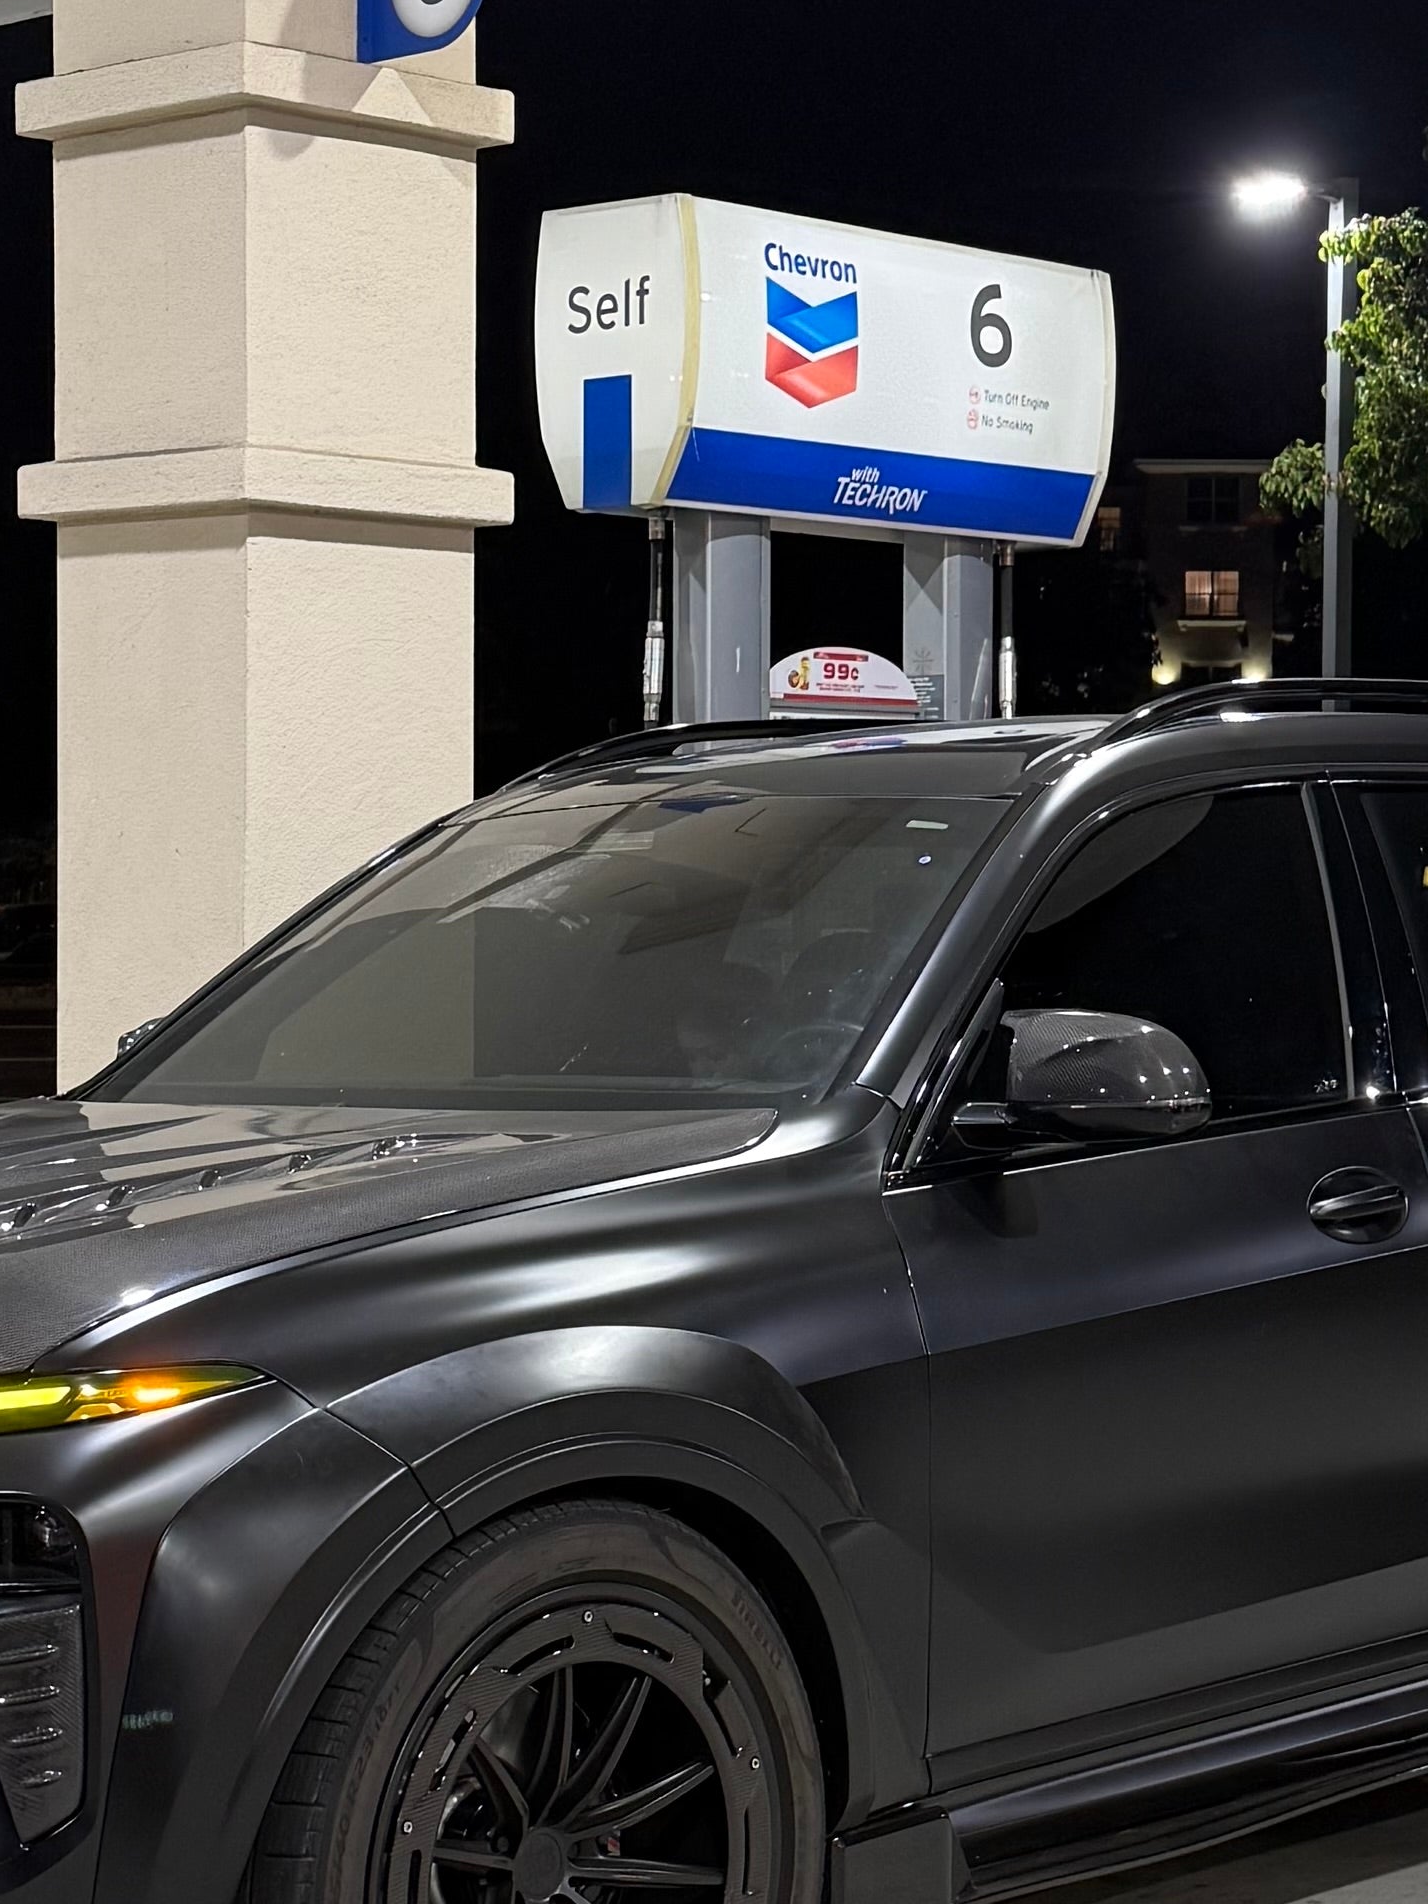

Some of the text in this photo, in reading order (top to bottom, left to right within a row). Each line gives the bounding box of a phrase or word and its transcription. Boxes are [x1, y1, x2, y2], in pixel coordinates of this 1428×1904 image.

[764, 242, 857, 284] Chevron
[568, 275, 651, 334] Self
[969, 283, 1013, 368] 6
[984, 389, 1003, 403] Turn
[1021, 395, 1050, 411] Engine
[981, 414, 1034, 435] No Smoking
[851, 466, 880, 483] with
[833, 476, 926, 515] TECHRON
